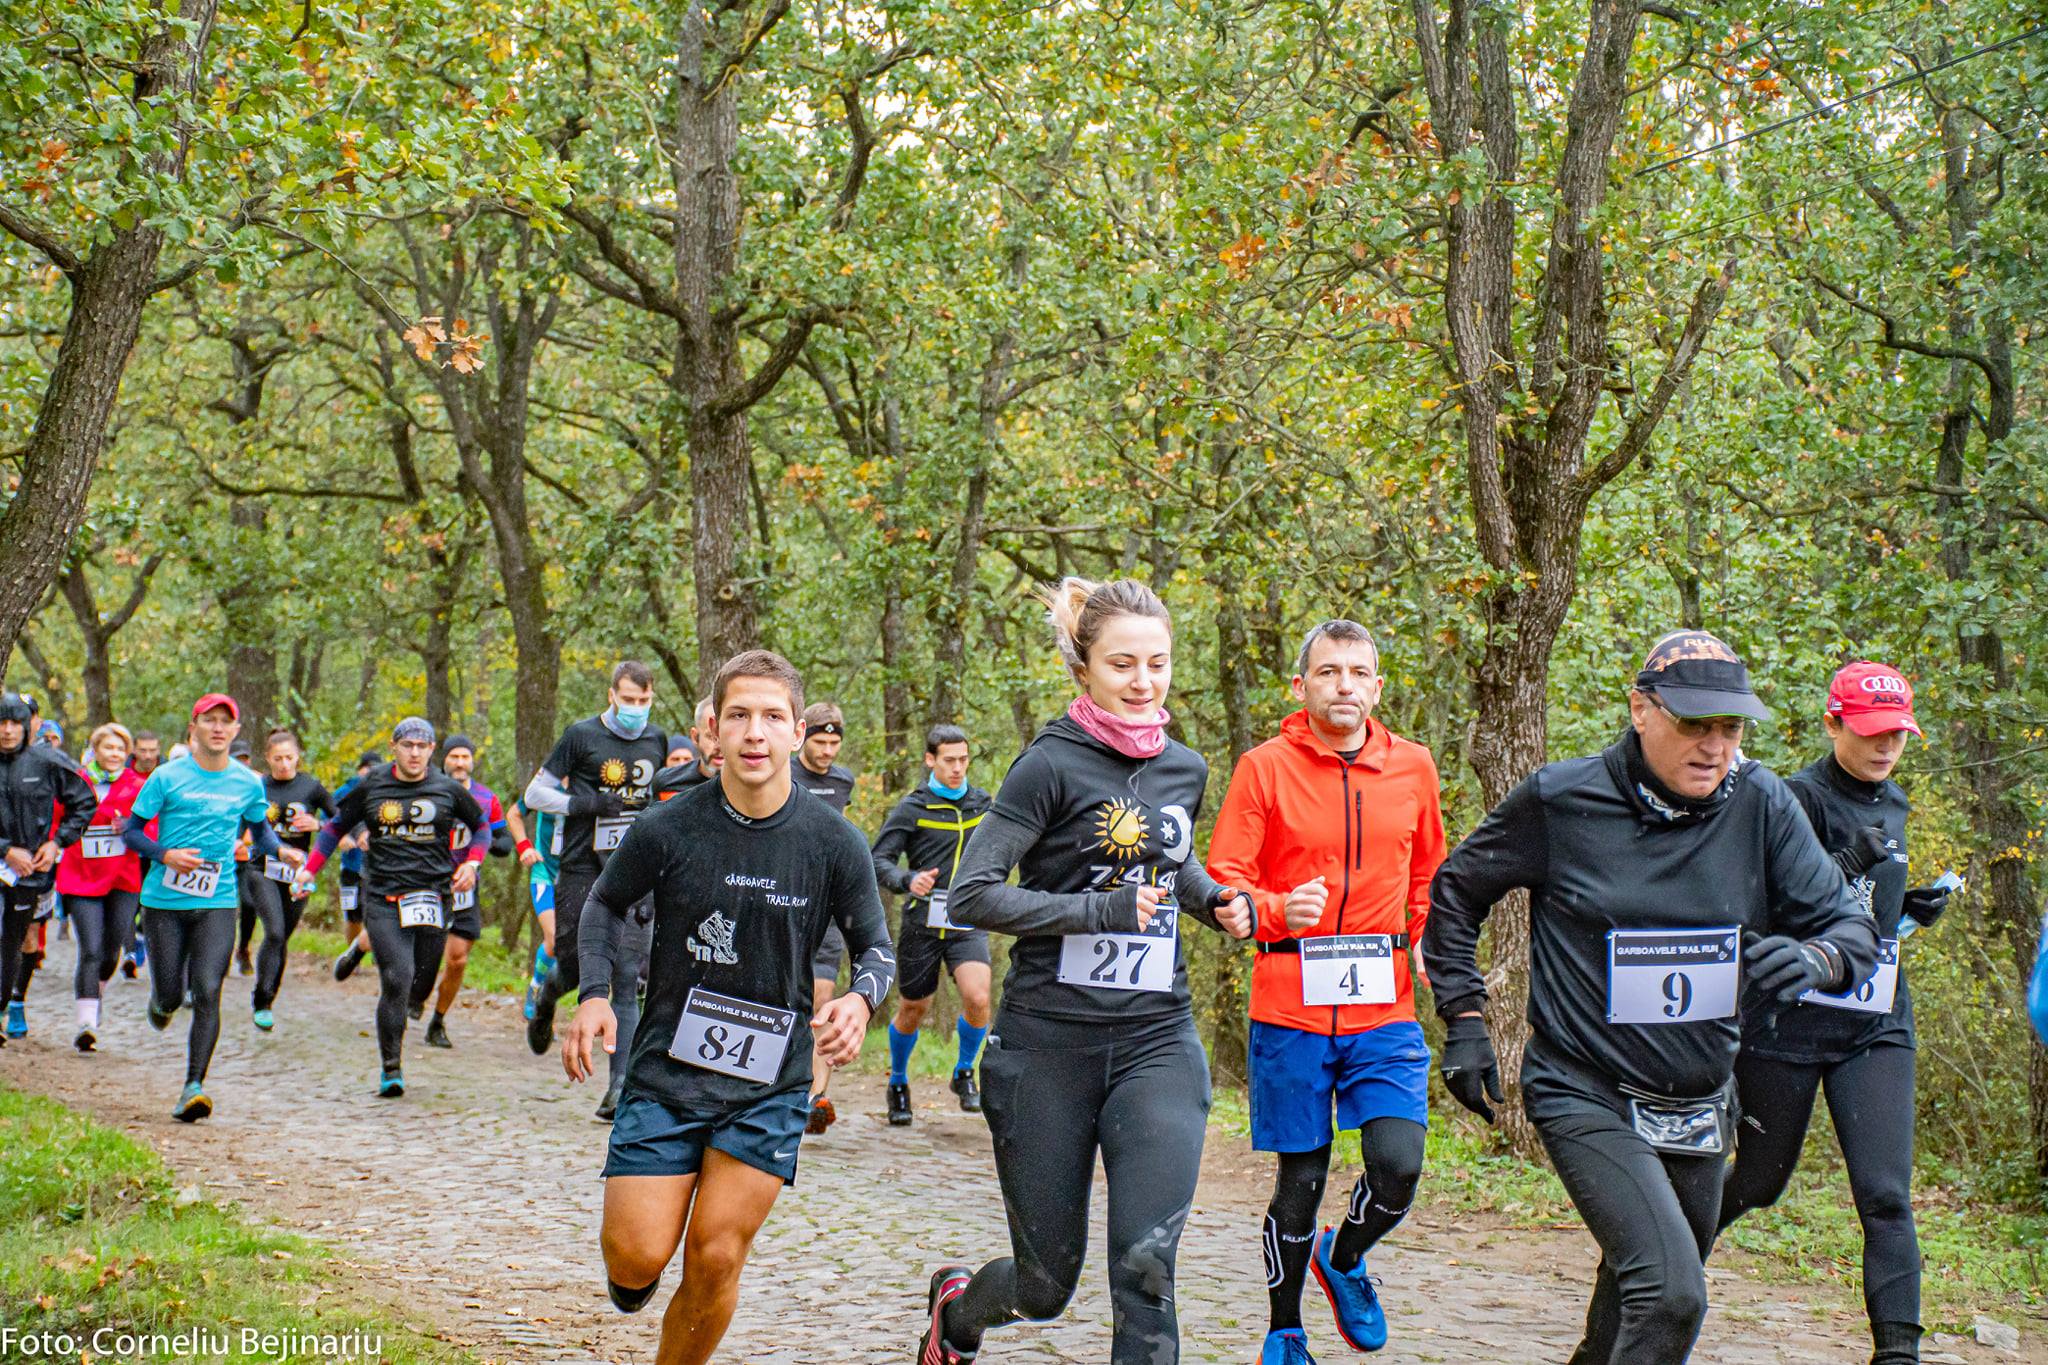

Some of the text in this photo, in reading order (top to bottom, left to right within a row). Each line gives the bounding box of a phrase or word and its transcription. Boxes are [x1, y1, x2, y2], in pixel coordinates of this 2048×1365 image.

[94, 839, 114, 855] 17
[172, 871, 212, 893] 126
[765, 894, 808, 907] TRAIL RUN
[412, 907, 436, 924] 53
[686, 936, 712, 963] GTR
[1678, 945, 1702, 955] TRAIL
[1702, 944, 1719, 953] RUN
[1089, 939, 1152, 985] 27
[1339, 963, 1365, 997] 4
[1662, 972, 1693, 1018] 9
[741, 1010, 760, 1022] TRAIL
[760, 1015, 776, 1026] RUN
[698, 1025, 756, 1070] 84
